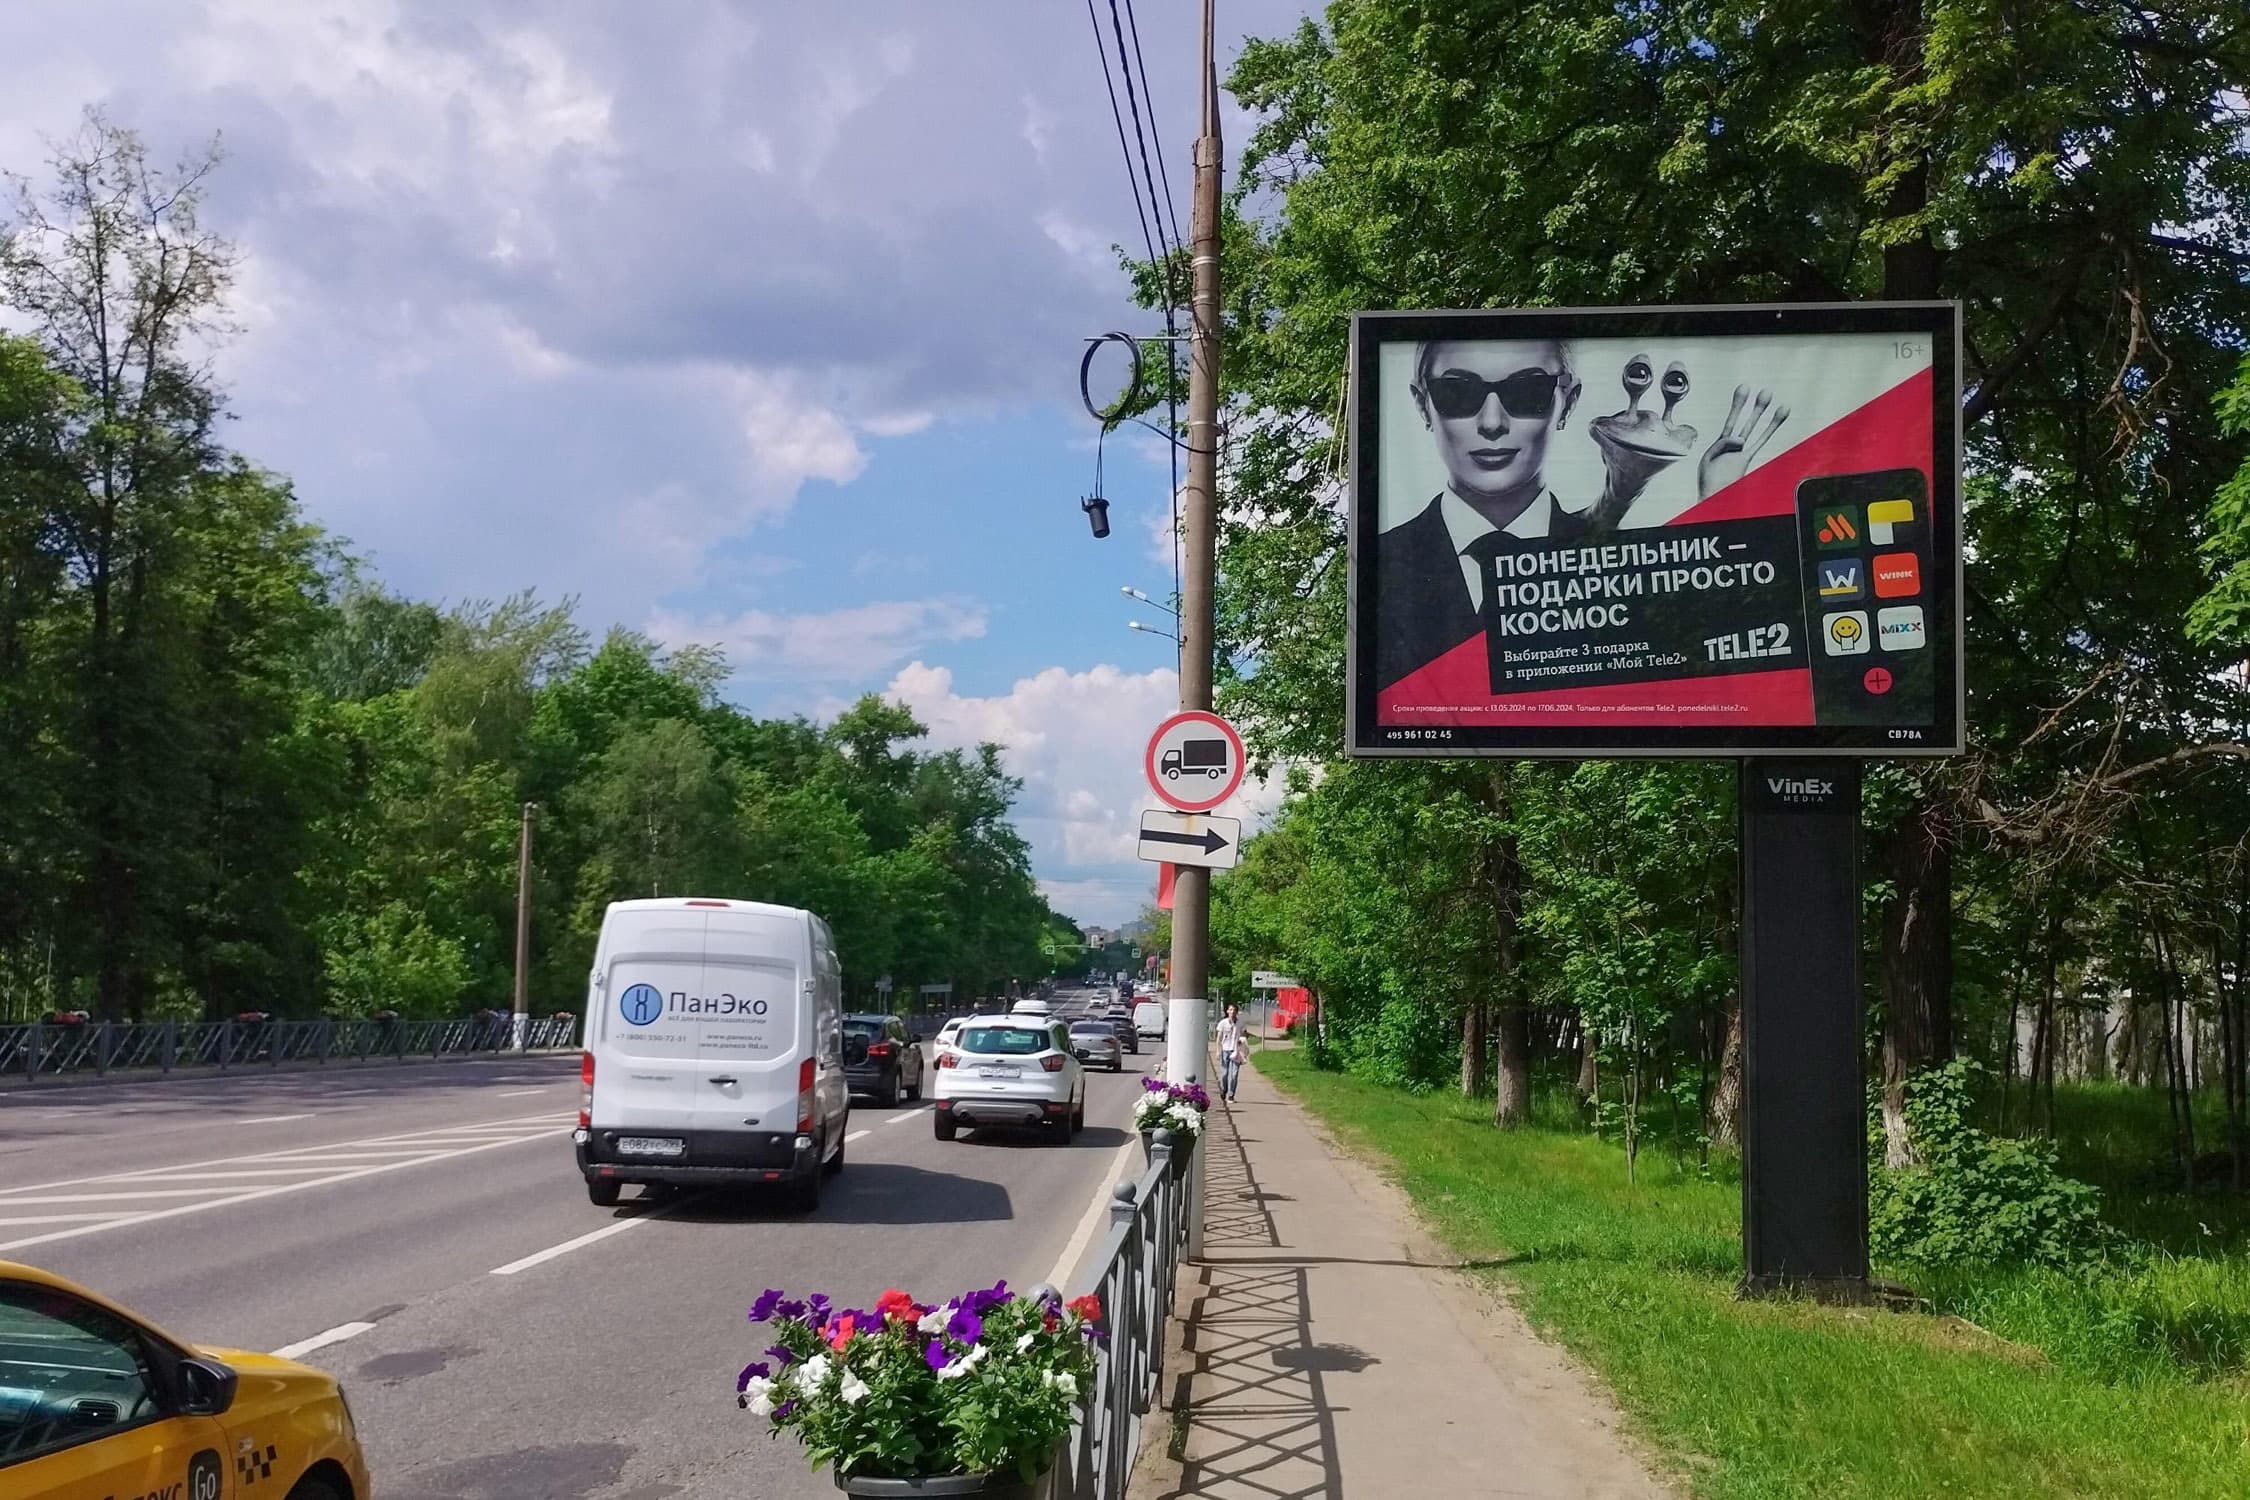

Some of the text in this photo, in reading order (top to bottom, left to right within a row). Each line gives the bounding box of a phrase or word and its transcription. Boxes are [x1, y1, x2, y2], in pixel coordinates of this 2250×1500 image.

[1892, 342, 1925, 359] 16+
[1495, 536, 1722, 578] ПОНЕДЕЛЬНИК
[1498, 561, 1775, 608] ПОДАРКИ ПРОСТО
[1880, 570, 1913, 580] WINK
[1500, 604, 1630, 637] КОСМОС
[1504, 642, 1650, 663] Выбирайте 3 подарка
[1703, 623, 1792, 662] TELE2
[1505, 652, 1688, 680] в приложении «Мой Tele2»
[1392, 704, 1415, 713] Сроки
[1490, 704, 1526, 712] 13.05.2024
[1576, 704, 1601, 712] Только
[1601, 705, 1615, 713] для
[1678, 704, 1749, 713] ponedelniki.tele2.ru
[1387, 730, 1452, 739] 495 961 02 45
[1767, 778, 1833, 795] VinEx
[1783, 795, 1823, 803] MEDIA
[669, 992, 768, 1015] ПанЭко
[195, 1465, 216, 1500] Go
